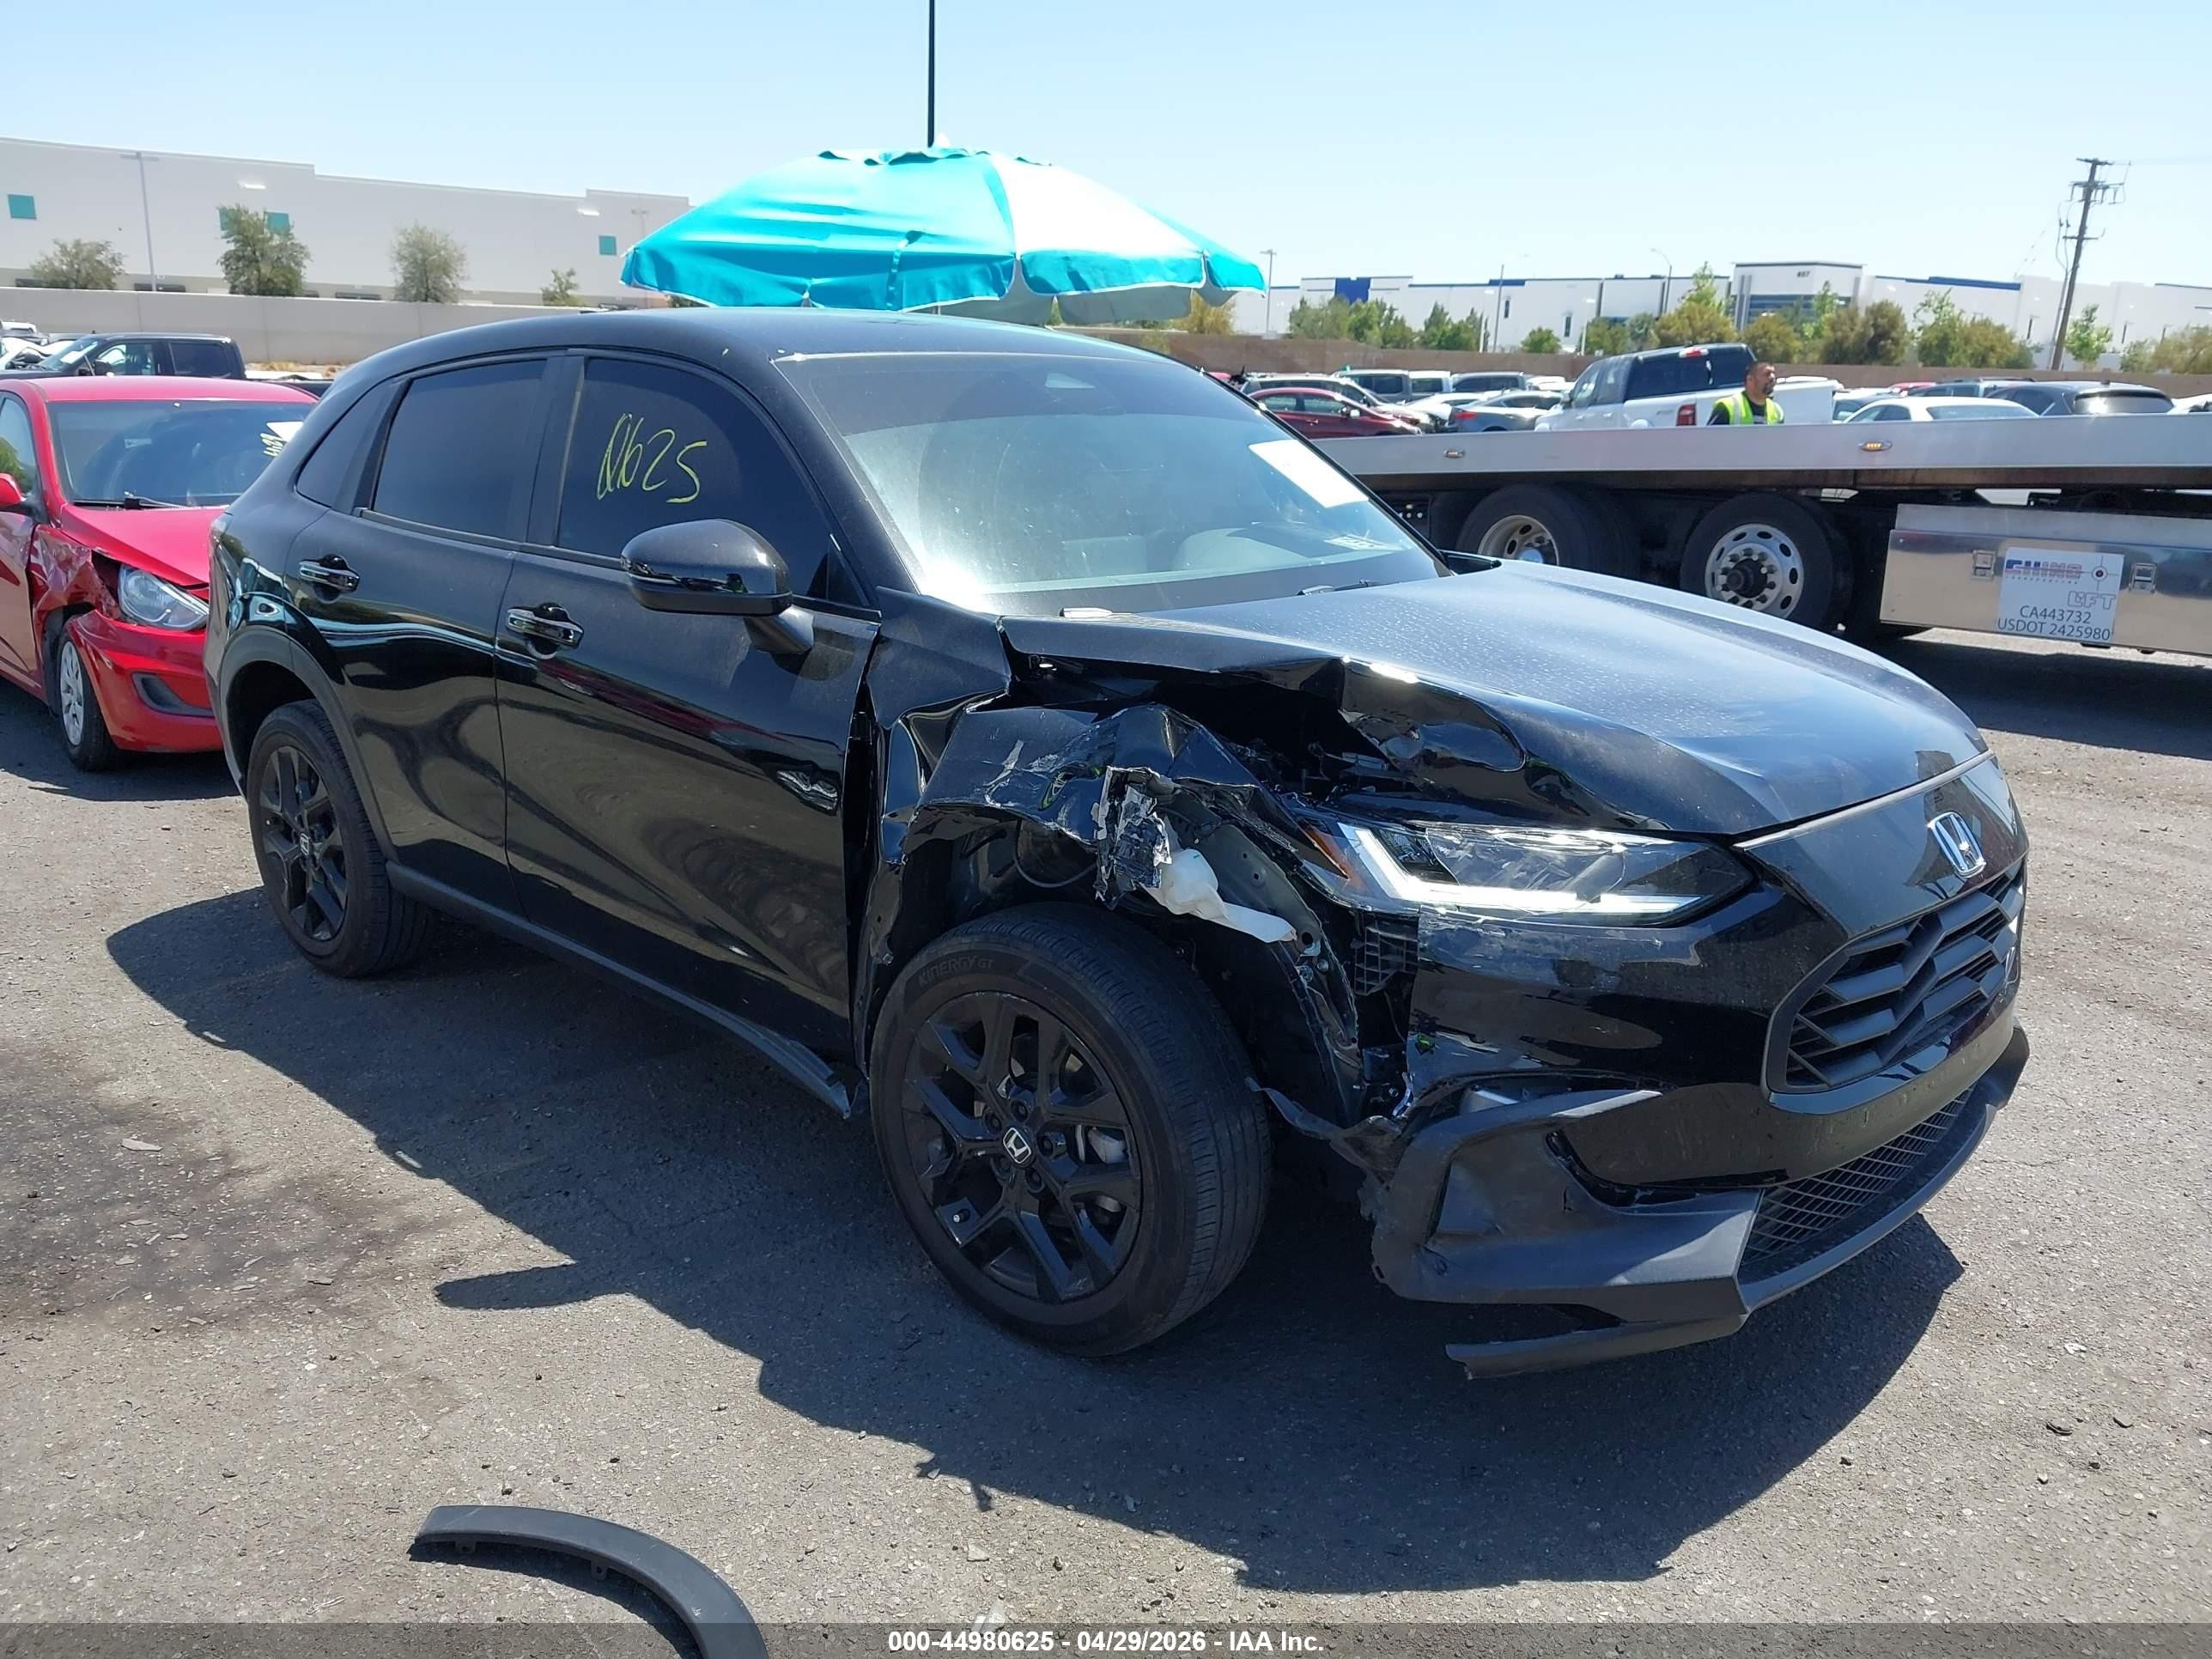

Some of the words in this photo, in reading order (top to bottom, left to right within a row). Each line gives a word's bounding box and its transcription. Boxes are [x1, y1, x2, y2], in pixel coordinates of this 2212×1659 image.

[2020, 605, 2092, 624] CA443732
[1997, 617, 2047, 634] USDOT
[2049, 623, 2111, 641] 2425980
